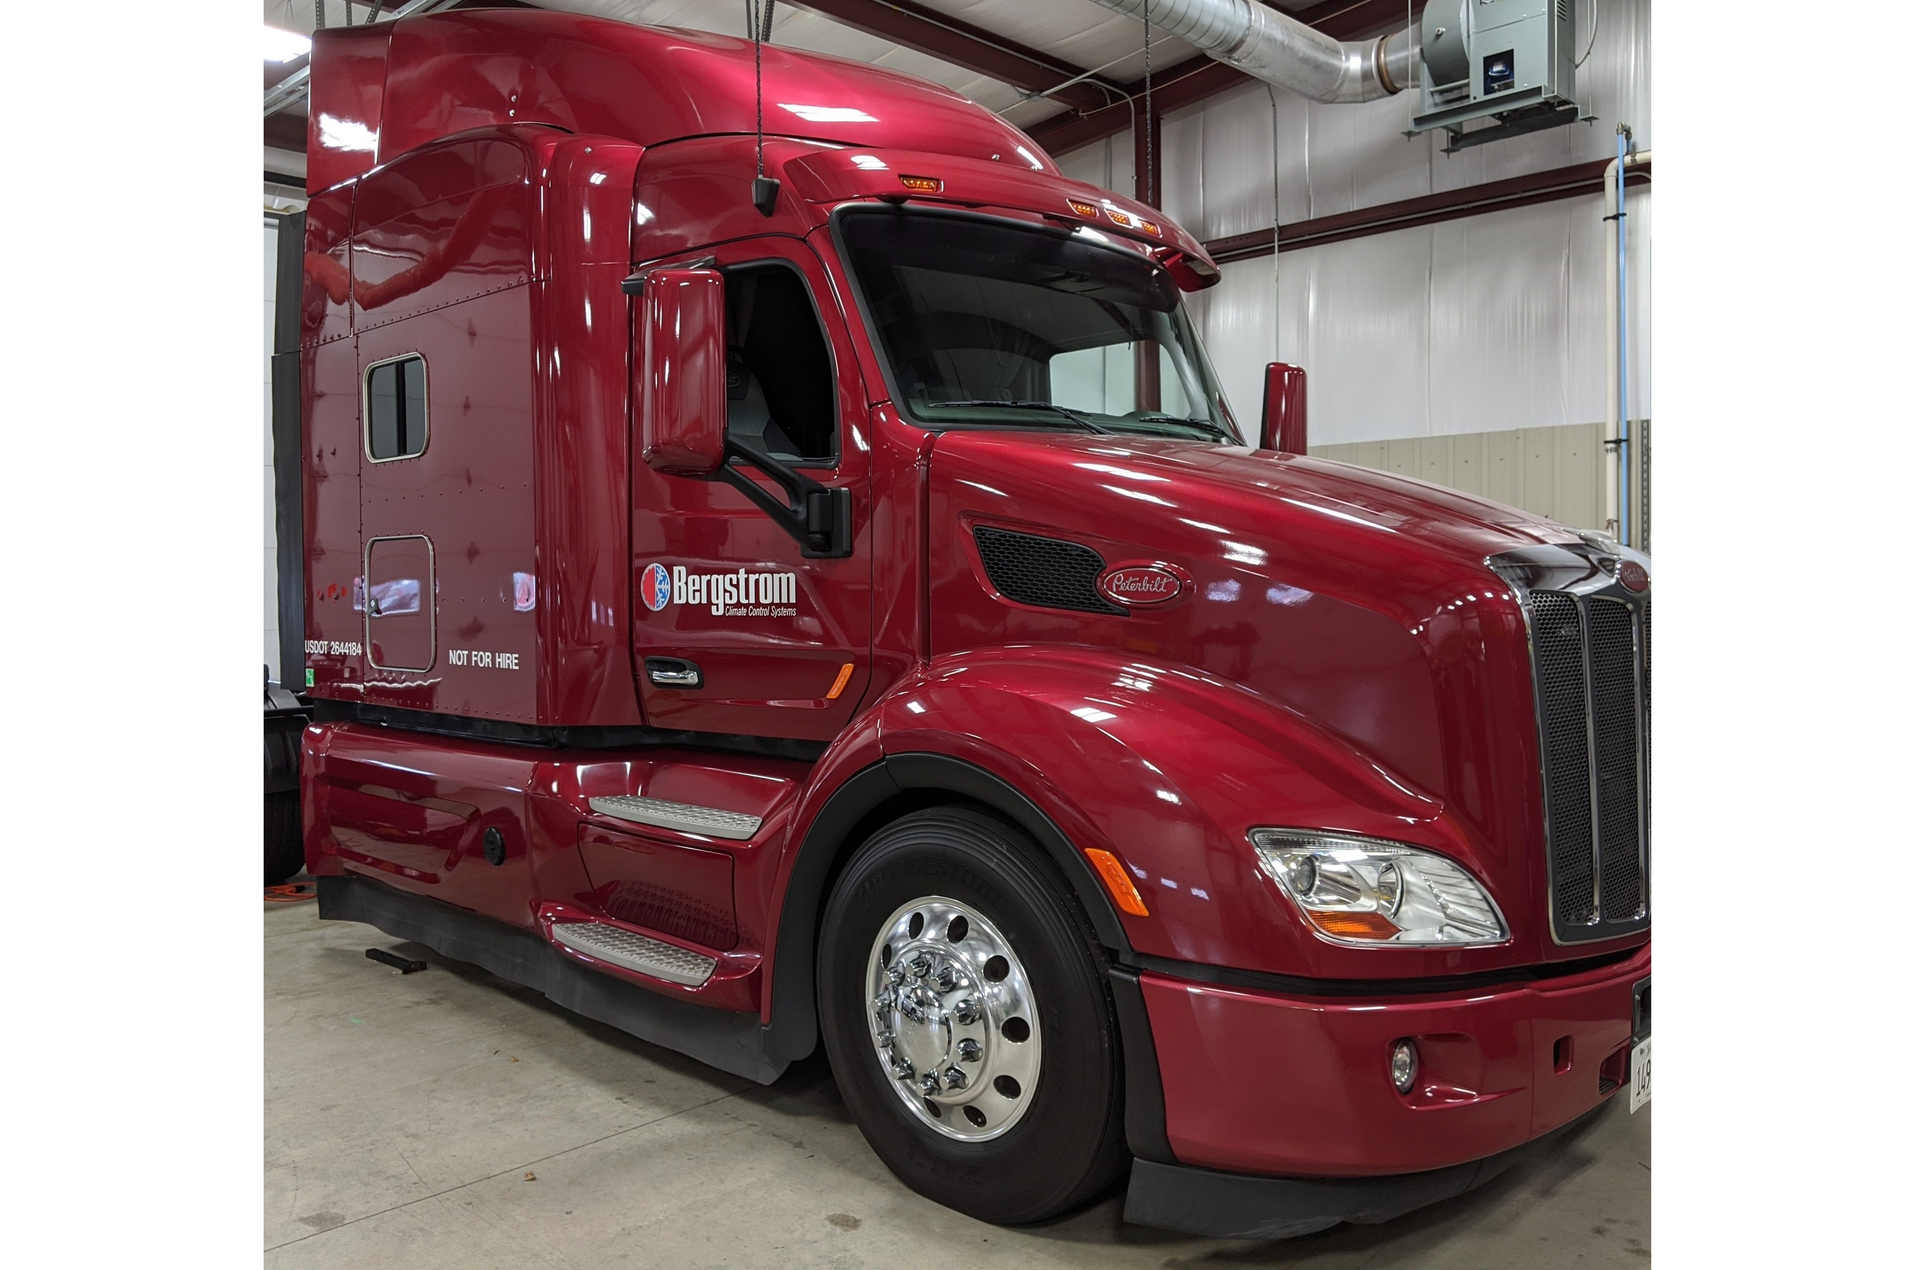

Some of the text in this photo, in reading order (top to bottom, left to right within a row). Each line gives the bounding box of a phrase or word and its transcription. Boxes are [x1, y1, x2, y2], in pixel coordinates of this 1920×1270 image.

[673, 566, 796, 616] Bergstrom
[1112, 573, 1173, 592] Peterbilt
[725, 605, 796, 618] Climate Control Systems
[304, 640, 362, 656] USDOT 2644184
[449, 650, 519, 670] NOT FOR HIRE
